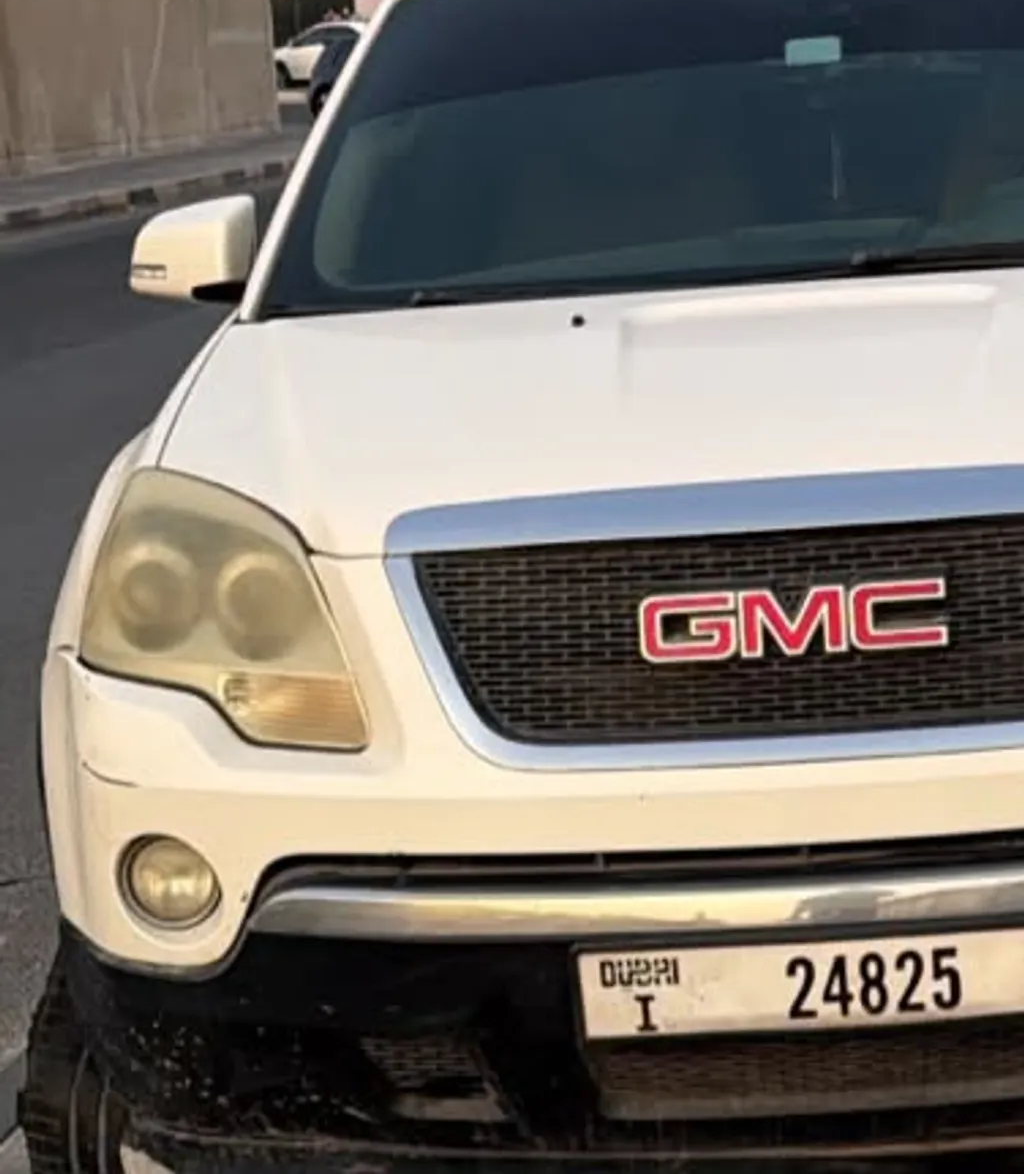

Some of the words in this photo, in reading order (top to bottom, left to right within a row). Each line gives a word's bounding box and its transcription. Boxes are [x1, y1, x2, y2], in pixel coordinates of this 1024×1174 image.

[640, 577, 949, 663] GMC
[600, 957, 680, 988] DUBAI
[786, 947, 962, 1020] 24825
